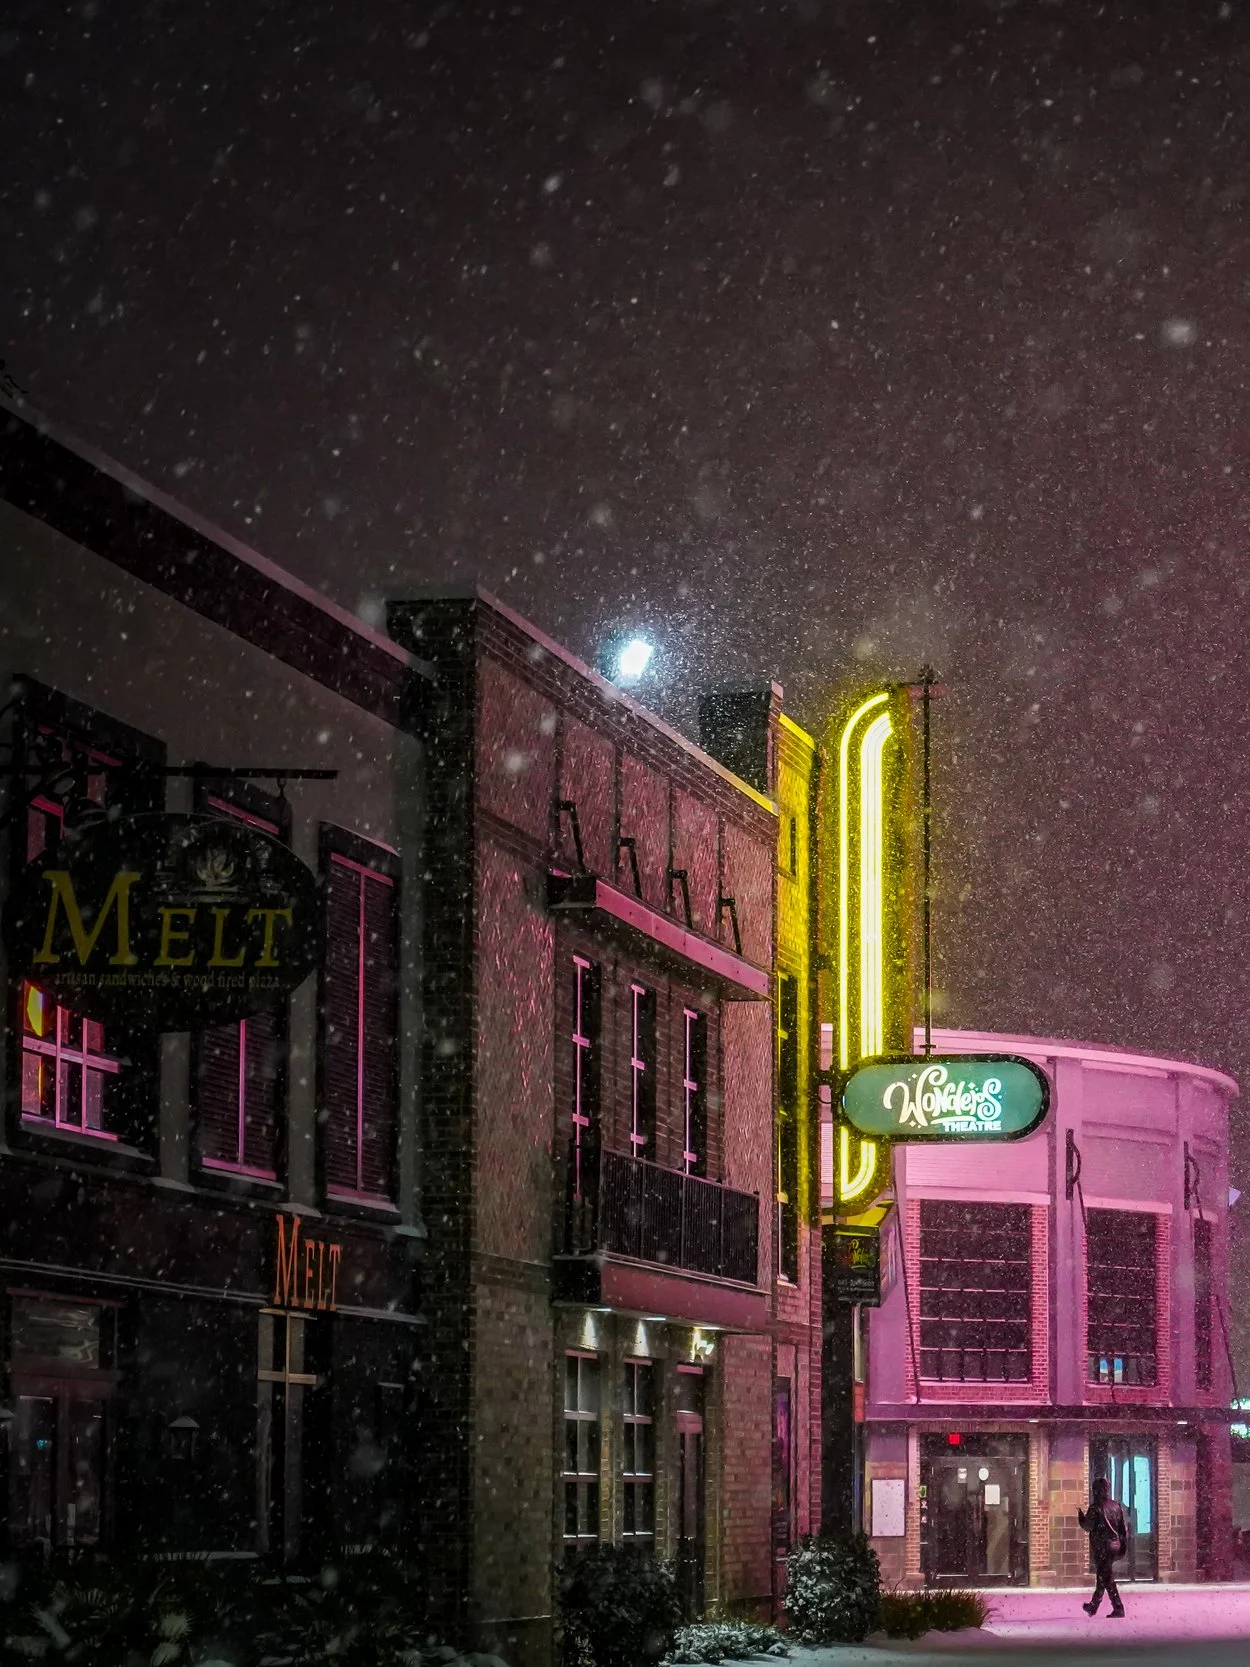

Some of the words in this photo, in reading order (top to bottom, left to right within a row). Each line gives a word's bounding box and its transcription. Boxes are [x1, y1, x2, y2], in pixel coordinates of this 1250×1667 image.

[33, 870, 293, 966] MELT
[55, 971, 96, 986] artisan
[100, 970, 167, 988] sandwiches
[183, 971, 214, 987] wood
[249, 971, 280, 989] pizza
[942, 1121, 1002, 1132] THEATRE
[273, 1213, 341, 1312] MELT
